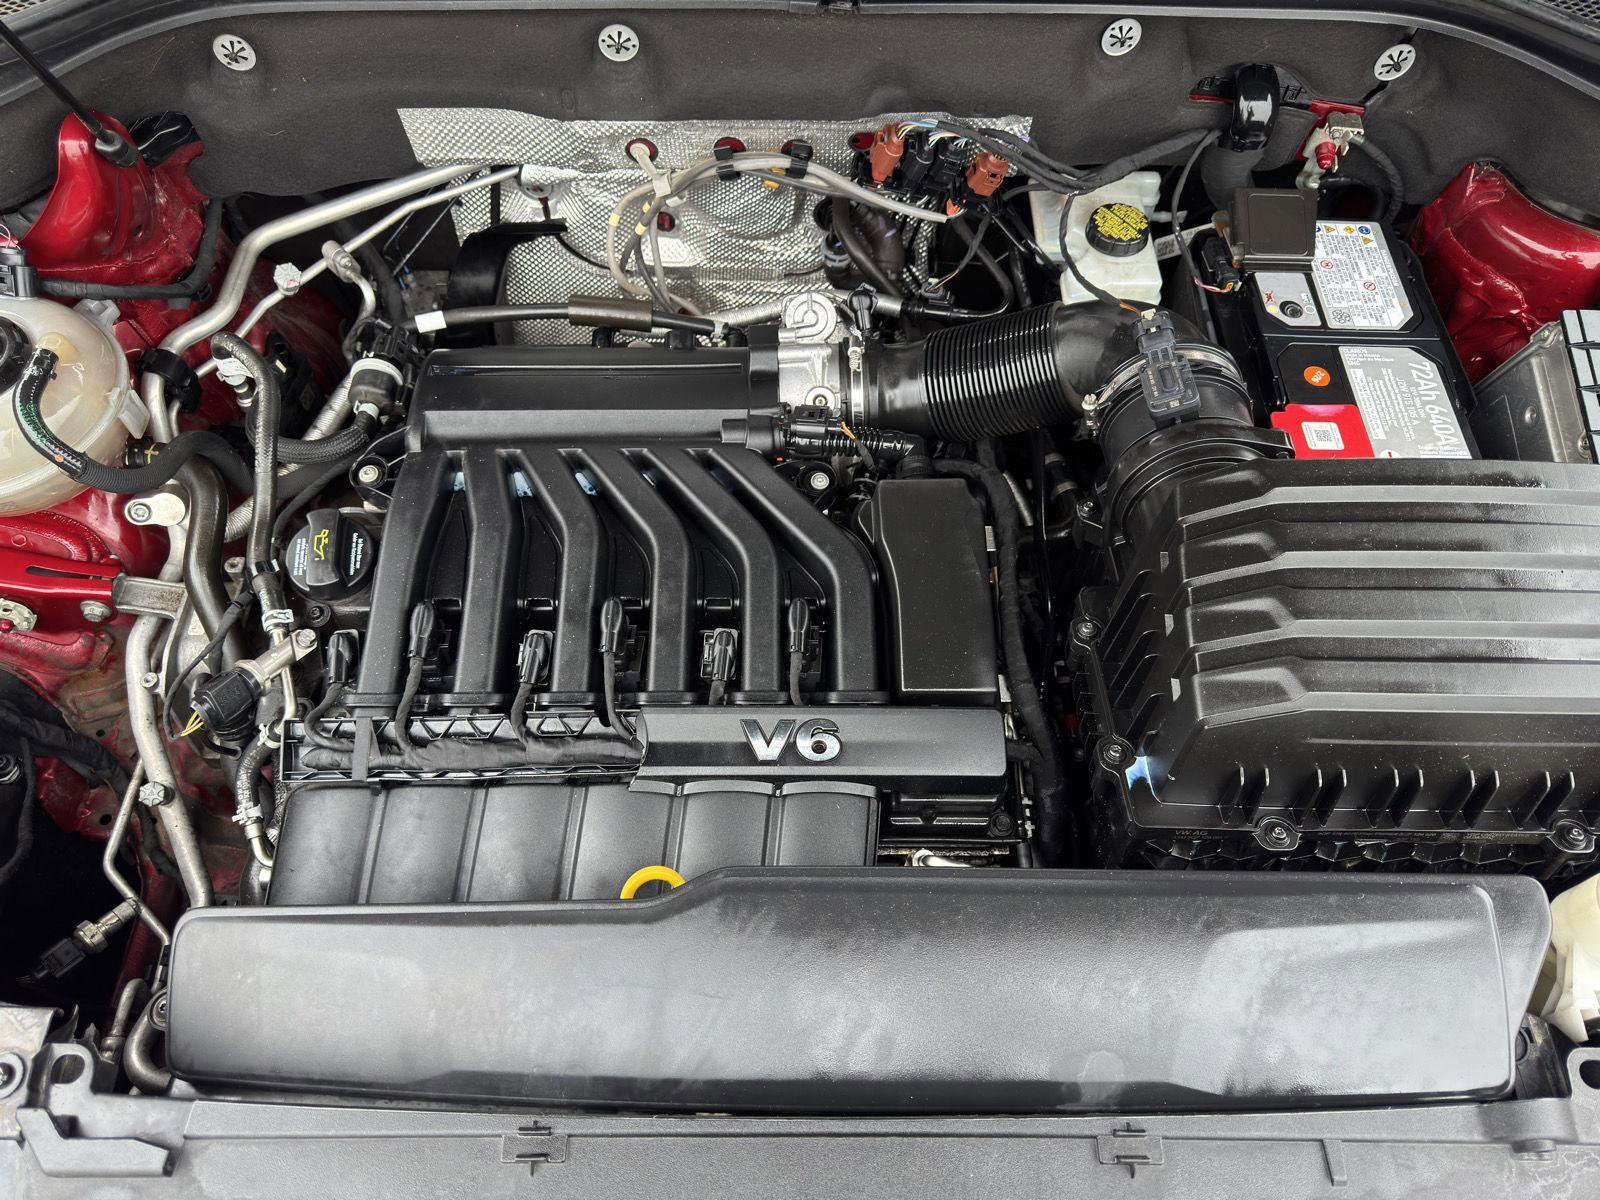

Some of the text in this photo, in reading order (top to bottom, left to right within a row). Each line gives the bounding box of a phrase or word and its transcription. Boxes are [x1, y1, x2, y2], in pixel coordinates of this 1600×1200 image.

[1408, 361, 1441, 400] 72Ah
[1425, 404, 1460, 445] 640A
[739, 717, 843, 762] V6
